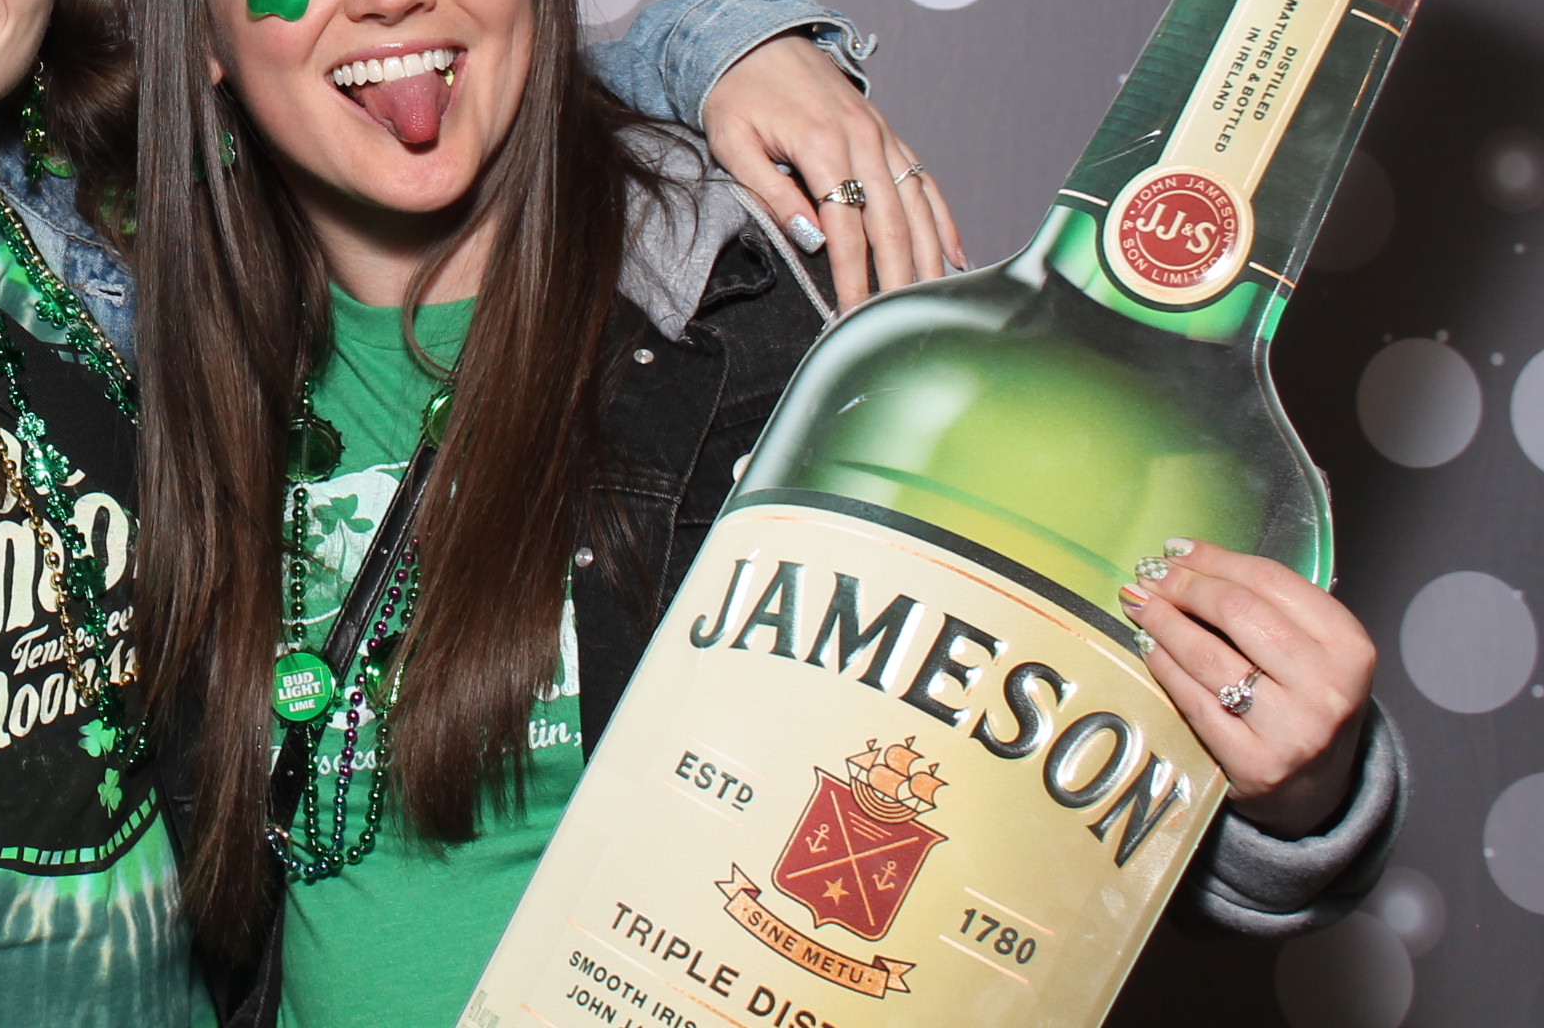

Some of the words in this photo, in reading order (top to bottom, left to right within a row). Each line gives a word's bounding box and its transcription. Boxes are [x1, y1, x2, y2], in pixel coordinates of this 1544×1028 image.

[1245, 26, 1261, 43] IN
[1212, 45, 1253, 111] IRELAND
[1247, 72, 1261, 83] &
[1252, 45, 1299, 121] DISTILLED
[1214, 85, 1256, 153] BOTTLED
[1122, 219, 1135, 230] &
[1134, 177, 1176, 209] JOHN
[1184, 177, 1236, 244] JAMESON
[1135, 202, 1218, 254] JJ&S
[1122, 238, 1149, 272] SON
[278, 681, 322, 701] LIGHT
[282, 672, 315, 688] BUD
[288, 699, 316, 713] LIME
[689, 557, 1193, 869] JAMESON
[611, 901, 741, 999] TRIPLE
[748, 909, 795, 953] SINE
[801, 942, 866, 985] METU
[958, 907, 1037, 965] 1780
[566, 985, 618, 1025] JOHN
[568, 950, 649, 1010] SMOOTH
